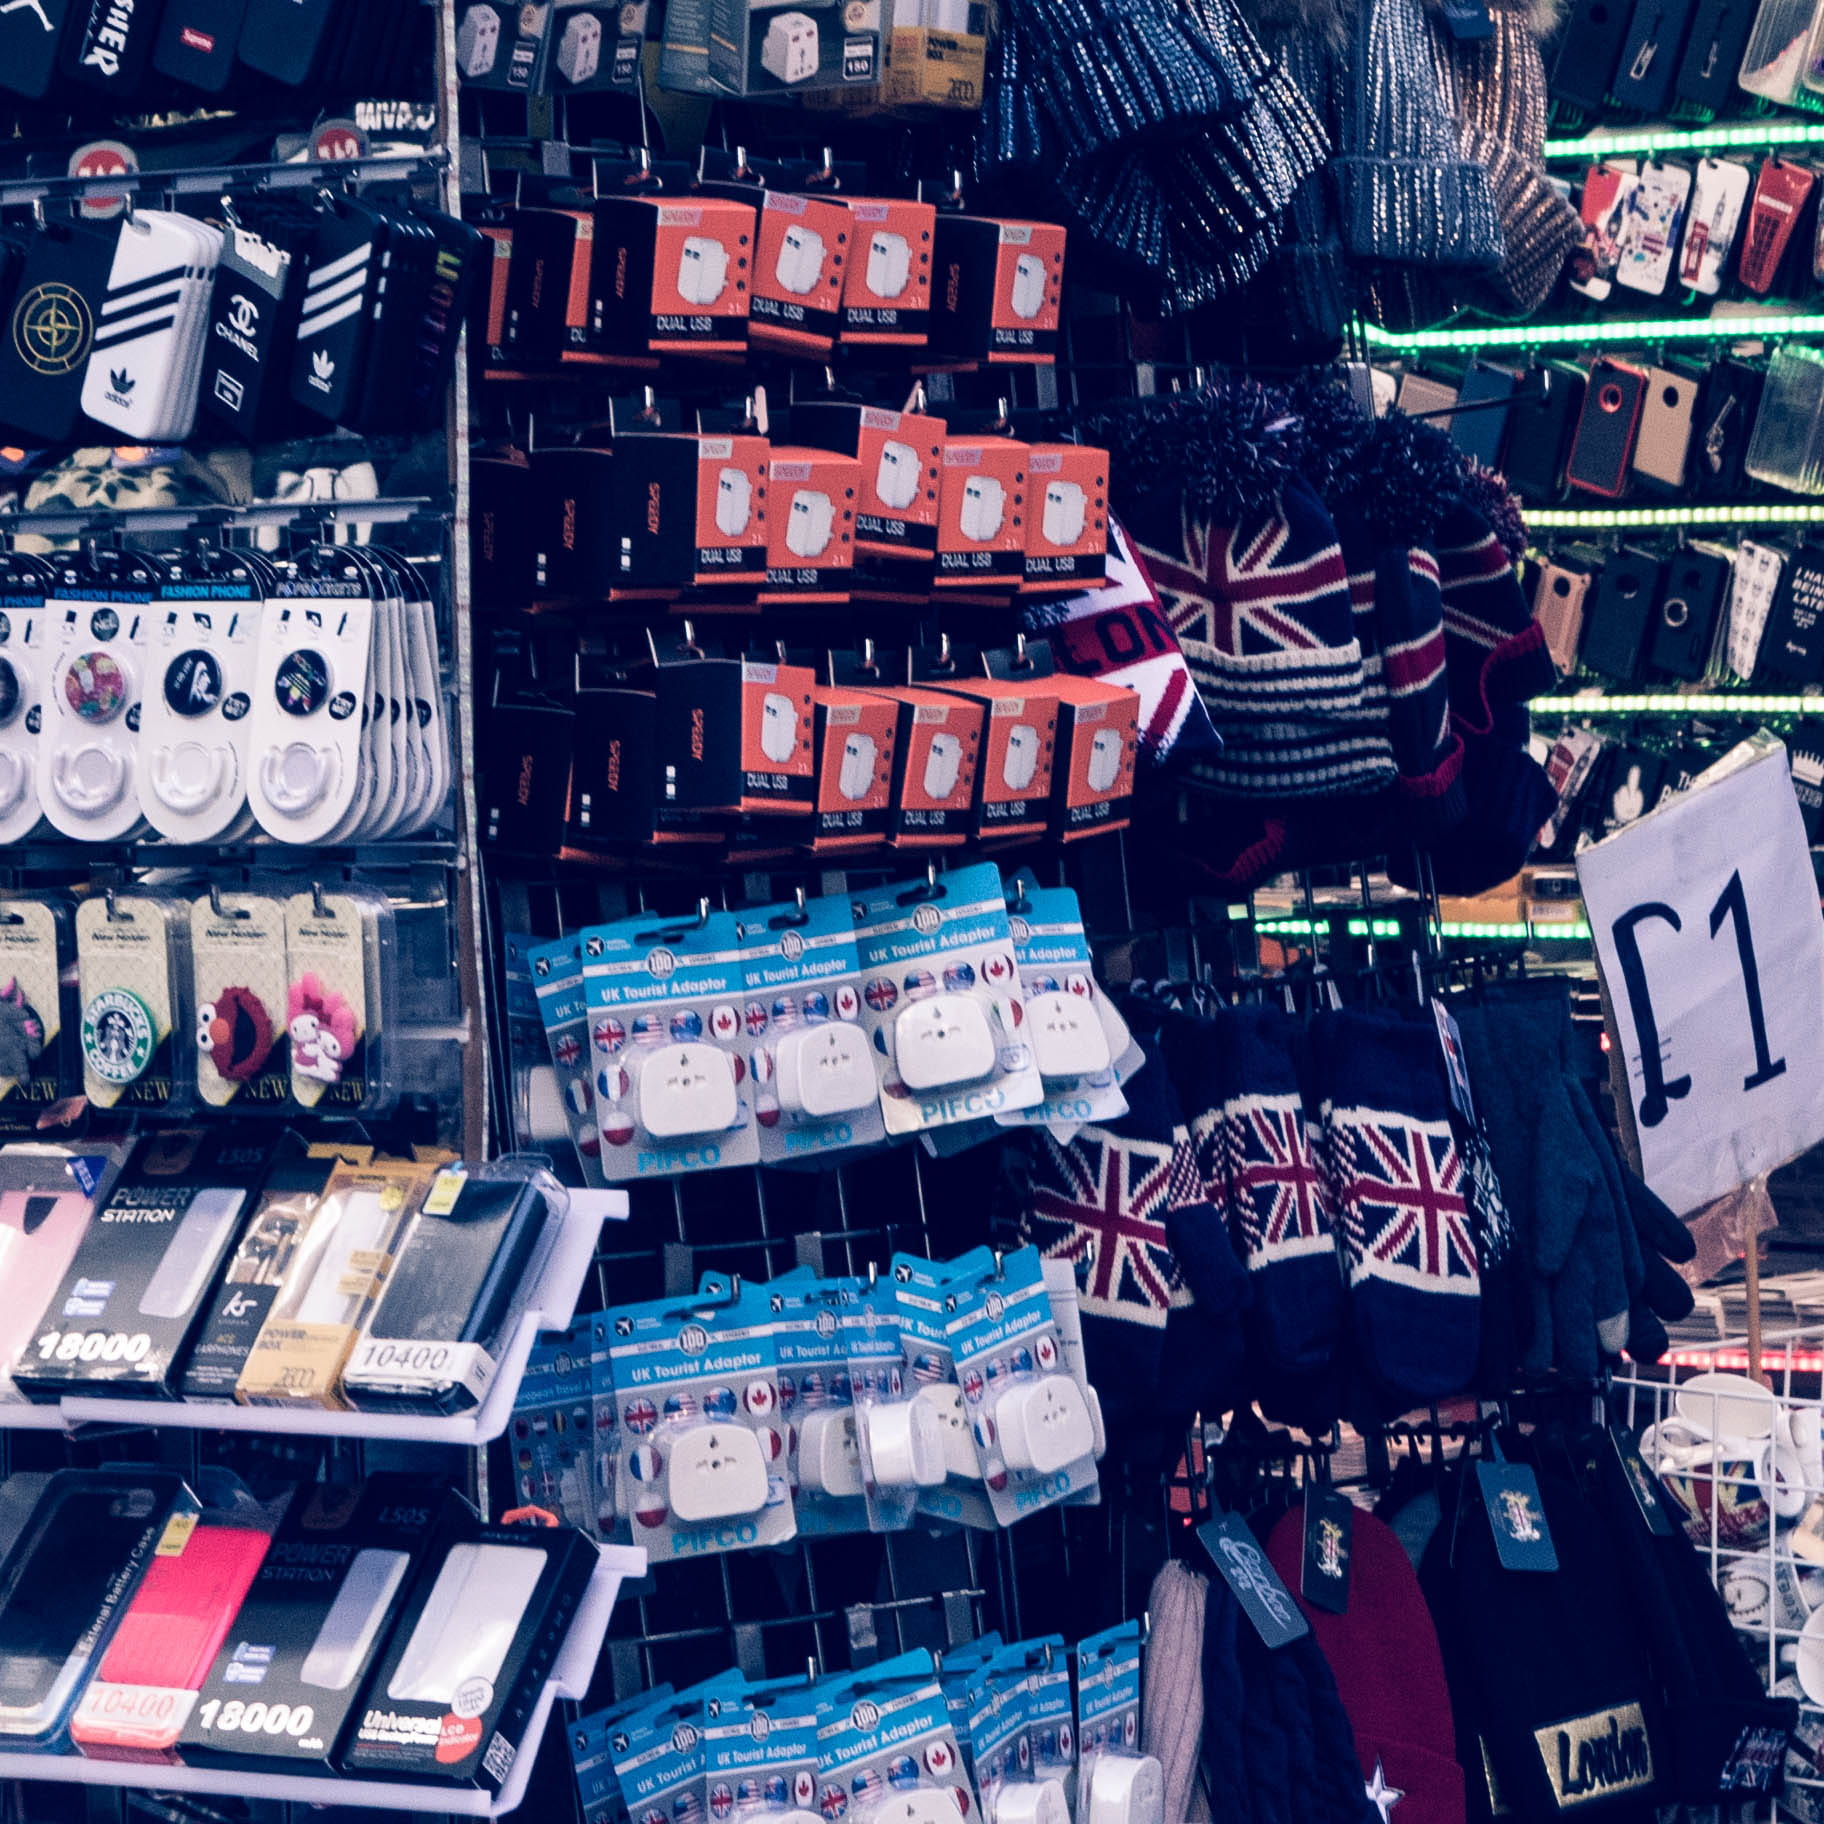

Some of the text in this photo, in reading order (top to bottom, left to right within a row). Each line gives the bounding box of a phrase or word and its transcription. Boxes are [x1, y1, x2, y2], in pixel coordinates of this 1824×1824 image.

[615, 247, 627, 298] SPEEDY
[656, 315, 712, 332] DUAL USB
[847, 307, 896, 324] DUAL USB
[214, 320, 261, 363] CHANEL
[104, 390, 131, 409] adidas
[648, 482, 661, 535] SPEEDY
[857, 514, 905, 536] DUAL USB
[160, 583, 251, 598] FASHION PHONE
[1052, 601, 1179, 679] LON
[690, 708, 703, 762] SPEEDY
[747, 773, 788, 790] DUAL USB
[869, 926, 996, 964] UK Tourist Adaptor
[601, 977, 727, 1003] UK Tourist Adaptor
[1611, 866, 1787, 1129] £1
[84, 991, 147, 1046] STARBUCKS
[15, 1081, 56, 1103] NEW
[130, 1081, 170, 1102] NEW
[244, 1081, 287, 1102] NEW
[921, 1088, 1005, 1124] PIFCO
[1023, 1099, 1093, 1121] PIFCO
[637, 1146, 721, 1172] PIFCO
[111, 1187, 188, 1208] POWER
[100, 1207, 176, 1224] STATION
[37, 1332, 150, 1364] 18000
[361, 1342, 449, 1372] 10400
[671, 1523, 758, 1554] PIFCO
[273, 1543, 353, 1566] POWER
[88, 1687, 171, 1718] 10400
[198, 1697, 314, 1736] 18000
[363, 1709, 442, 1734] Universal
[1557, 1710, 1650, 1796] London
